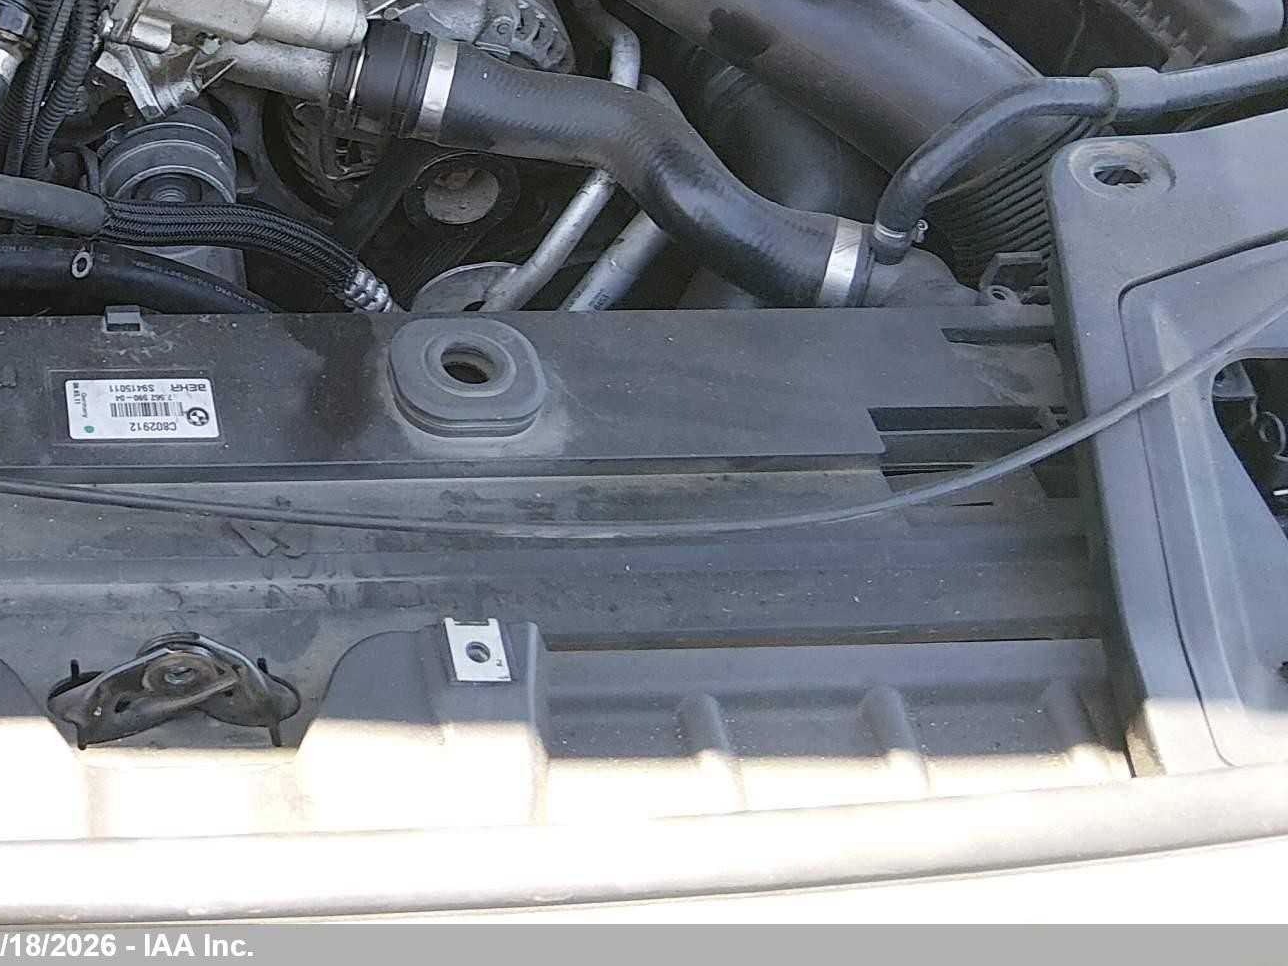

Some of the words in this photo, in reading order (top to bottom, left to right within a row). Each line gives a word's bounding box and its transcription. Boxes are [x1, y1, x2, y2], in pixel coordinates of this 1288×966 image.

[109, 384, 155, 393] S9415011
[170, 384, 207, 392] BEHR
[129, 421, 177, 432] C802912
